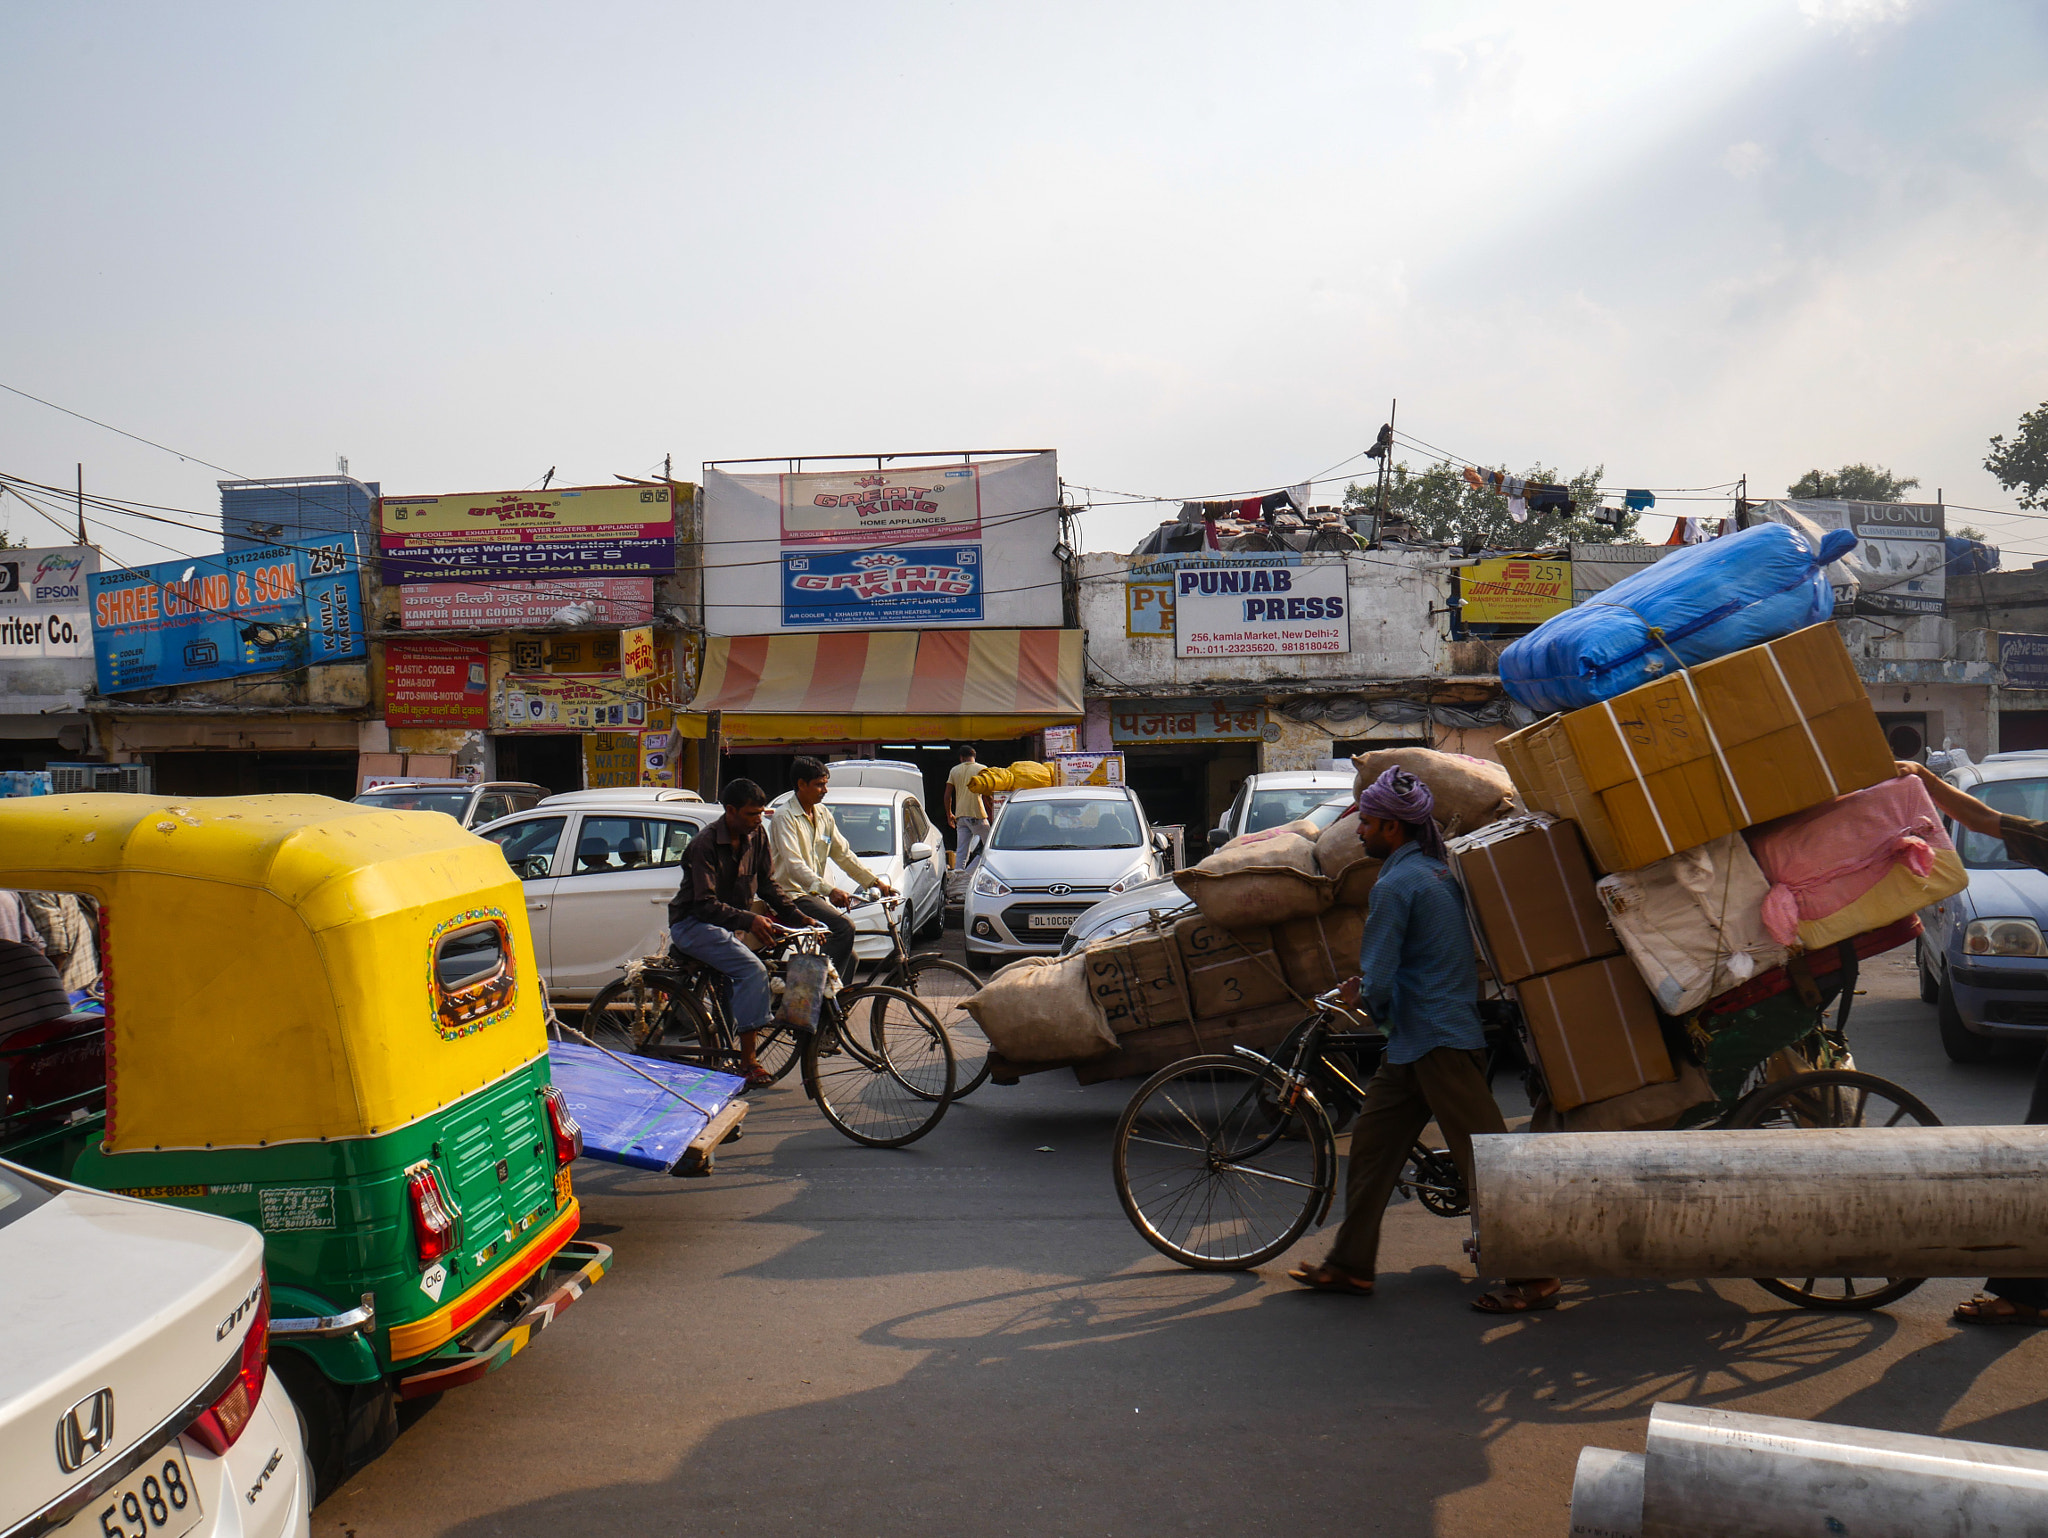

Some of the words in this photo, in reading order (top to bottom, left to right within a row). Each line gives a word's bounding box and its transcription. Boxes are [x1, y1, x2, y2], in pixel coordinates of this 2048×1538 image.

[814, 487, 931, 507] GREAT
[467, 502, 551, 516] GREAT
[498, 509, 556, 521] KING
[856, 499, 938, 517] KING
[1862, 504, 1934, 524] JUGNU
[598, 523, 644, 531] APPLIANCES
[889, 517, 946, 525] APPLIANCES
[1859, 526, 1913, 537] SUBMERSIBLE
[1915, 529, 1939, 538] PUMP
[226, 548, 293, 566] 9312246862
[388, 548, 429, 556] Kamla
[433, 544, 479, 555] Market
[483, 544, 532, 553] Welfare
[431, 550, 622, 565] WELCOMES
[308, 543, 345, 575] 254
[403, 568, 490, 578] President
[794, 566, 961, 590] GREAT
[1535, 565, 1563, 581] 257
[857, 580, 971, 599] KING
[1178, 569, 1293, 597] PUNJAB
[1468, 581, 1511, 595] JAIPUR
[1512, 582, 1561, 597] GOLDEN
[36, 585, 79, 599] EPSON
[96, 584, 159, 628] SHREE
[163, 574, 231, 617] CHAND
[235, 570, 251, 607] &
[255, 563, 296, 603] SON
[405, 595, 452, 609] कानपुर
[456, 591, 494, 604] दिल्ली
[405, 610, 449, 619] KANPUR
[452, 608, 482, 618] DELHI
[486, 607, 524, 617] GOODS
[1243, 596, 1344, 621] PRESS
[129, 616, 203, 635] PREMIUM
[319, 590, 335, 651] KAMLA
[334, 582, 352, 654] MARKET
[0, 616, 42, 645] riter
[47, 614, 79, 645] Co.
[1191, 632, 1212, 643] 256,
[1213, 632, 1243, 641] kamla
[1243, 631, 1280, 642] Market,
[1282, 630, 1303, 639] New
[1304, 629, 1339, 638] Delhi-2
[625, 644, 653, 665] GREAT
[1207, 643, 1278, 654] 011-23235620,
[1281, 641, 1340, 651] 9818180426
[395, 665, 423, 674] PLASTIC
[428, 665, 455, 674] COOLER
[635, 656, 653, 673] KING
[397, 678, 436, 687] LOHA-BODY
[540, 685, 598, 696] GREAT
[396, 691, 464, 700] AUTO-SWING-MOTOR
[562, 691, 603, 700] KING
[1116, 707, 1204, 737] पंजाब
[594, 754, 637, 768] WATER
[596, 771, 637, 786] WATER
[1223, 976, 1245, 1002] 3
[425, 1270, 442, 1288] CNG
